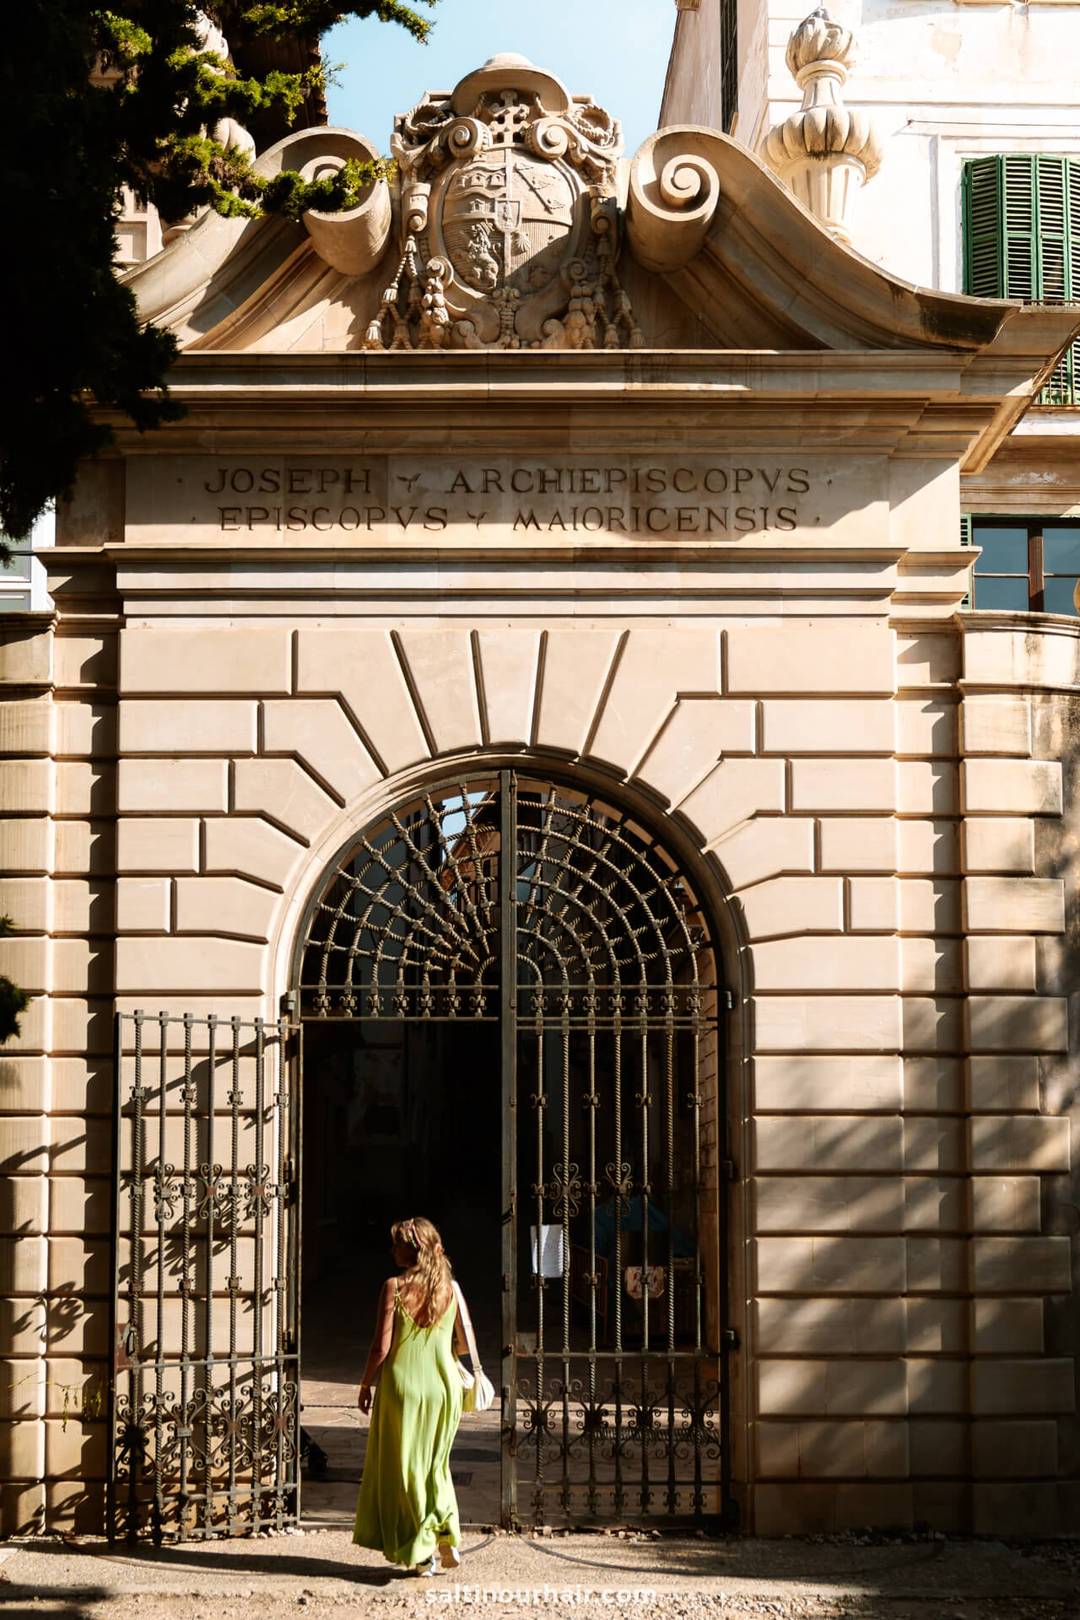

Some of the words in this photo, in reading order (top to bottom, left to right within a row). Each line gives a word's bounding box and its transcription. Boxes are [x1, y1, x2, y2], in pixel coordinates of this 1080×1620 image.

[205, 468, 371, 494] JOSEPH
[444, 468, 811, 494] ARCHIEPISCOPVS
[217, 506, 448, 532] EPISCOPVS
[512, 506, 798, 532] MAIORICENSIS
